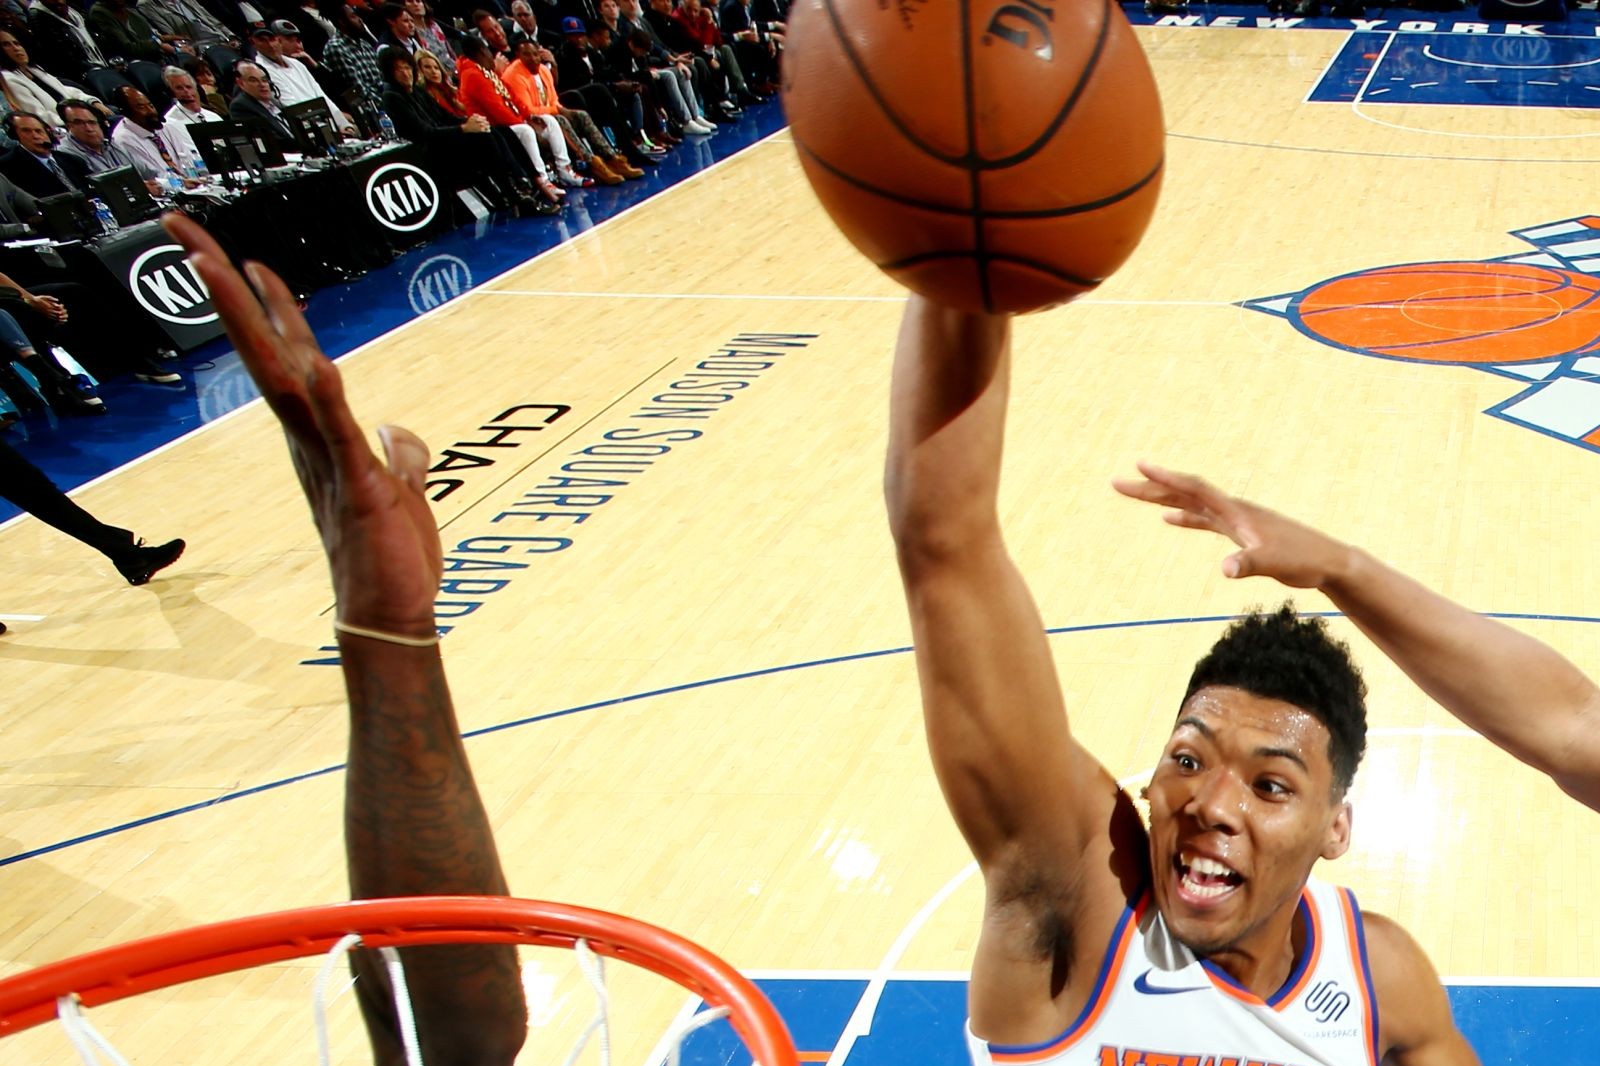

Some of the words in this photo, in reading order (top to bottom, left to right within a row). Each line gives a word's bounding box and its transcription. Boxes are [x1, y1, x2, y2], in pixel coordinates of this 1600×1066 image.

[1155, 15, 1304, 29] NEW
[1350, 19, 1546, 35] YORK
[373, 174, 432, 222] KIA
[630, 332, 820, 419] MADISON
[425, 403, 572, 502] CHAS
[490, 428, 704, 524] SQUARE
